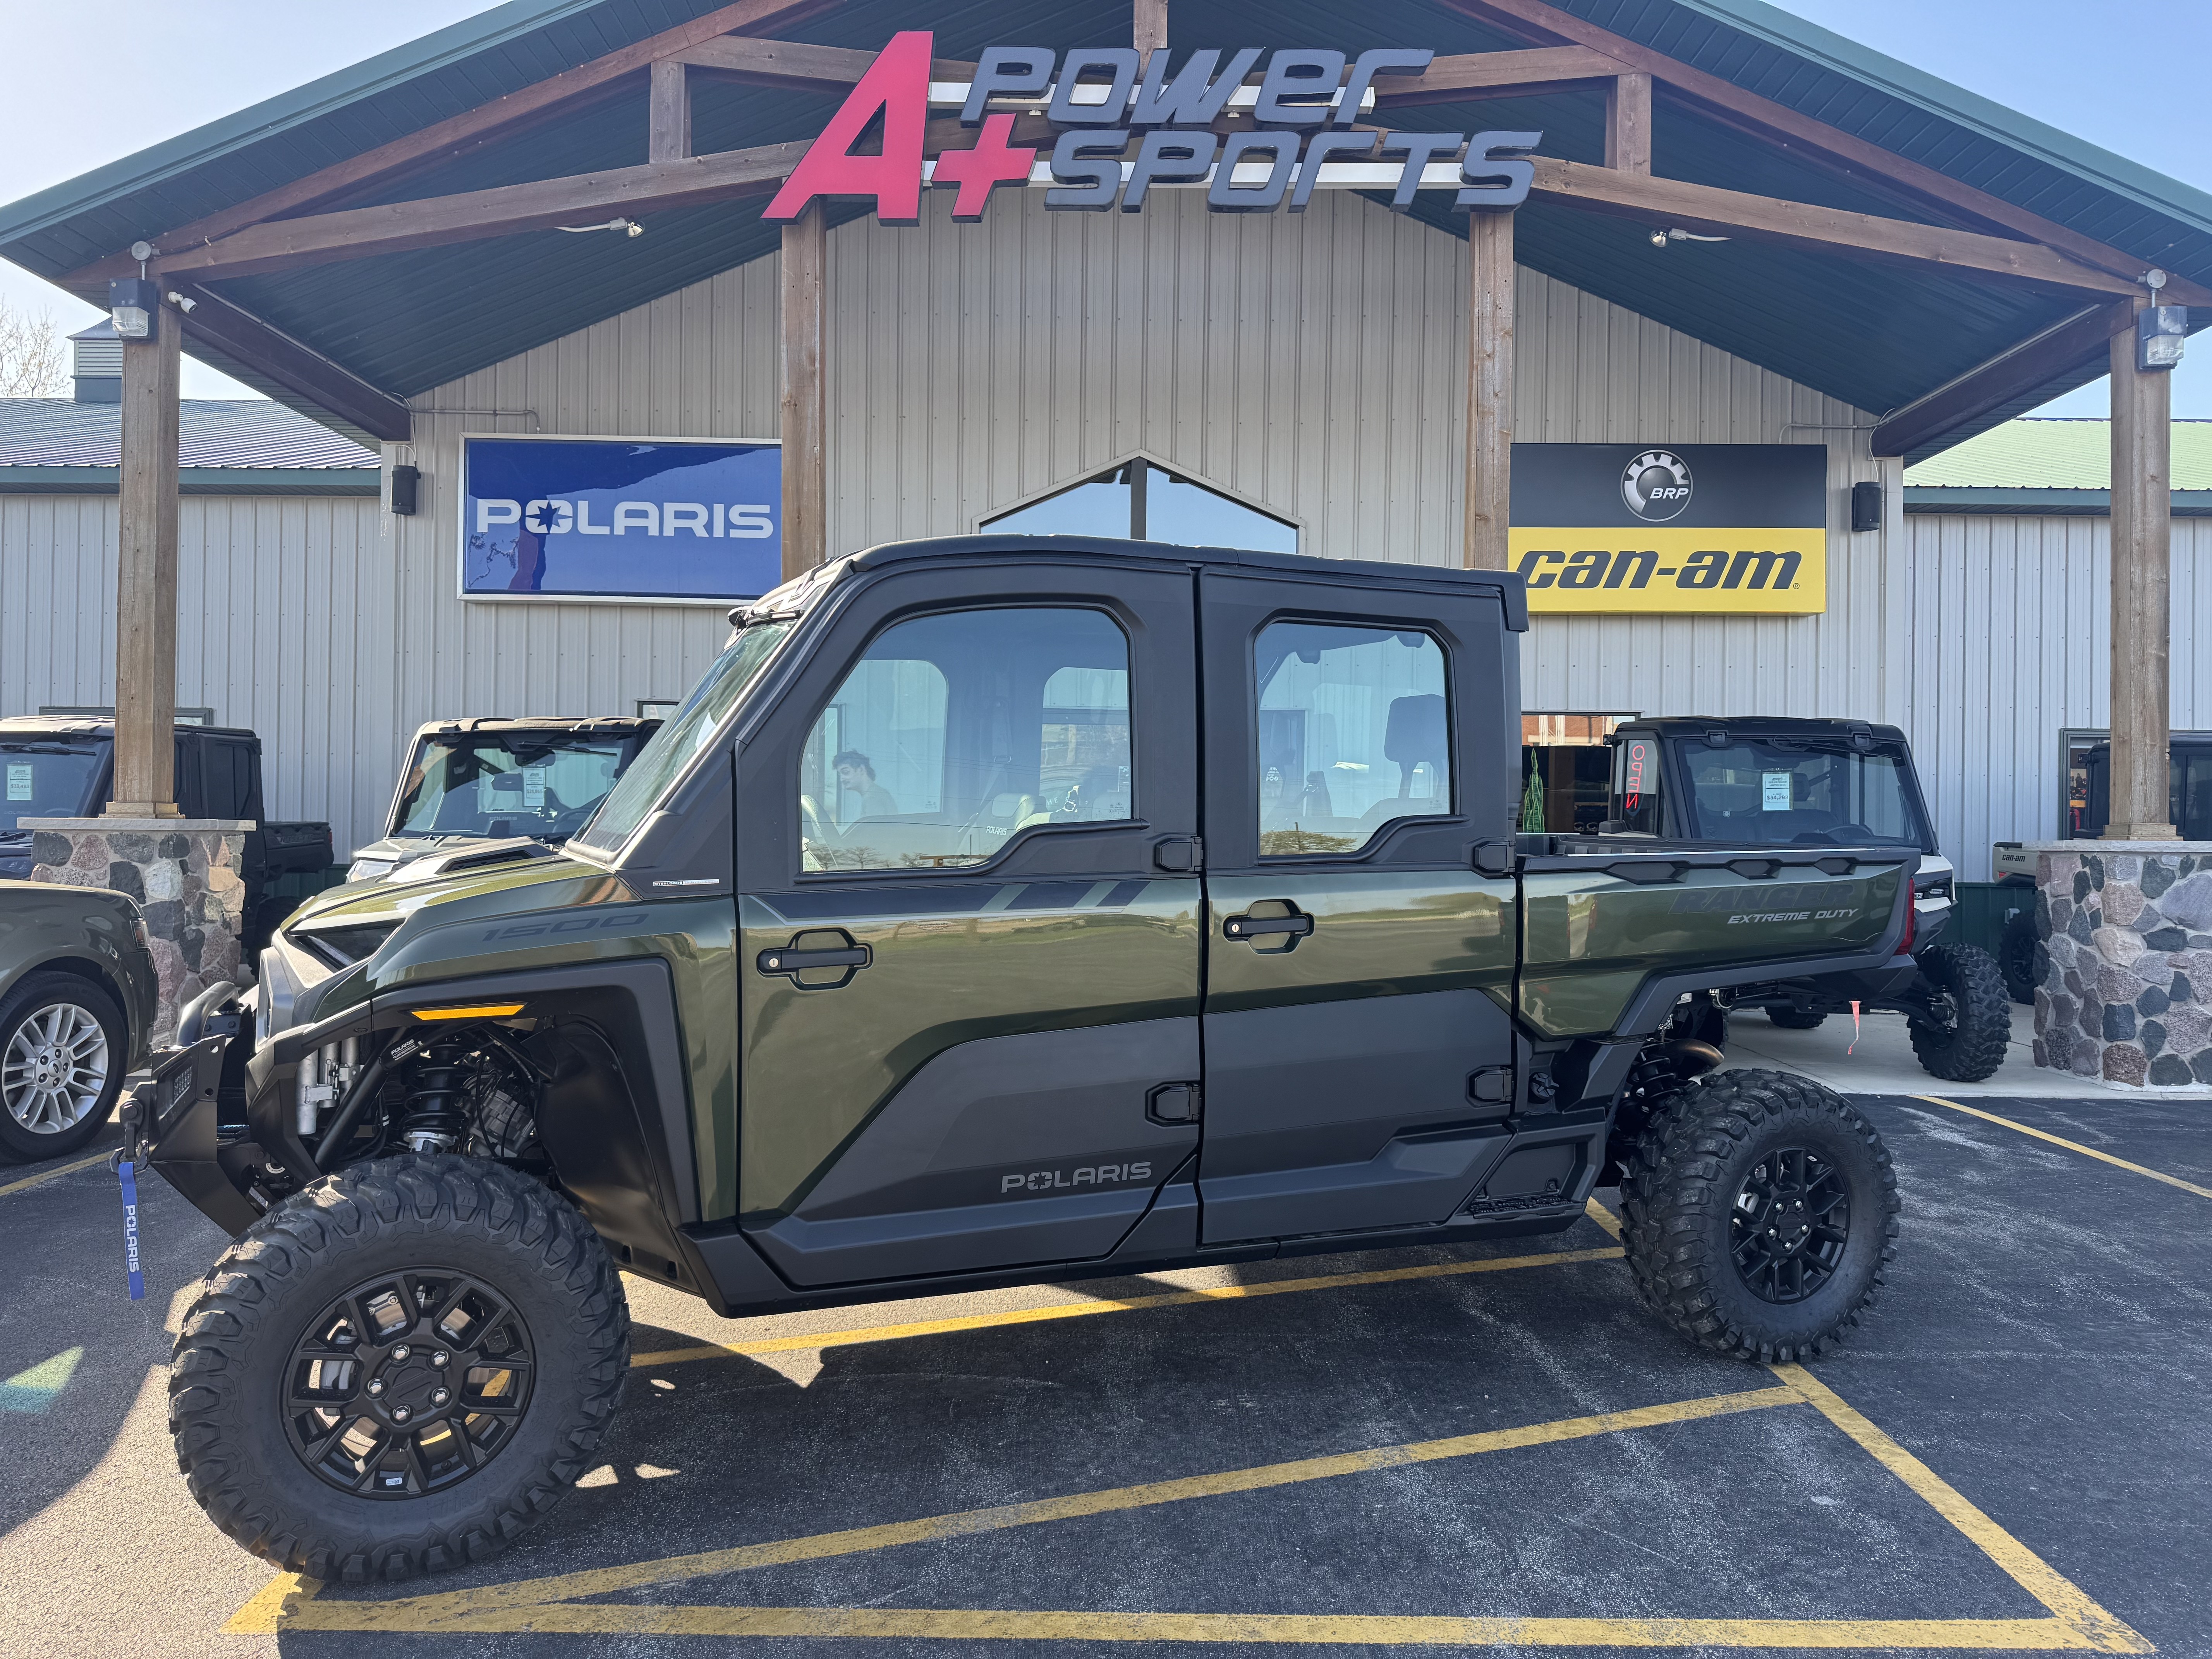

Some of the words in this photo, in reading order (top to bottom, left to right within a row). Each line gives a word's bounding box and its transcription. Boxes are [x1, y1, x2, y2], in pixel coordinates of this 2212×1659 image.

[761, 30, 1038, 227] A+
[1650, 488, 1689, 499] BRP
[477, 499, 773, 538] POLARIS
[986, 826, 1007, 835] POLARIS
[1668, 883, 1855, 914] RANGER
[482, 913, 649, 941] 1500
[1727, 912, 1811, 924] EXTREME
[1815, 908, 1859, 919] DUTY
[391, 1039, 414, 1055] POLARIS
[1001, 1161, 1152, 1193] POLARIS
[125, 1205, 140, 1273] POLARIS
